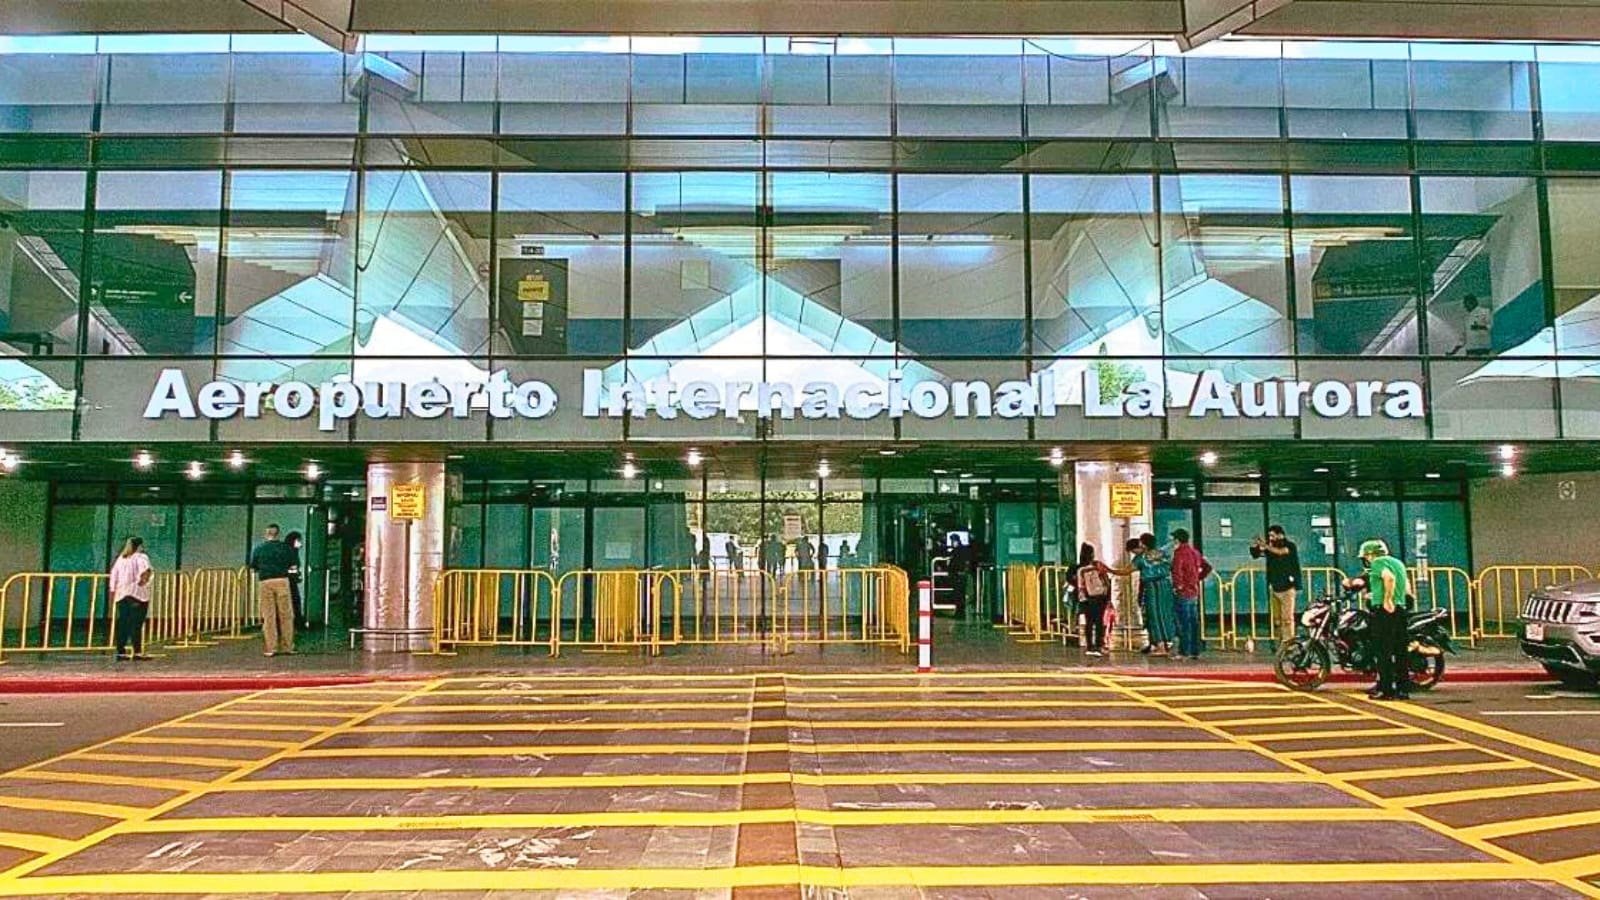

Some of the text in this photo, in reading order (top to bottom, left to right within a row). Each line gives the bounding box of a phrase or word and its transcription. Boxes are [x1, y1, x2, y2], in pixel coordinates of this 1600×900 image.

[143, 368, 1424, 431] Aeropuerto Internacional La Aurora
